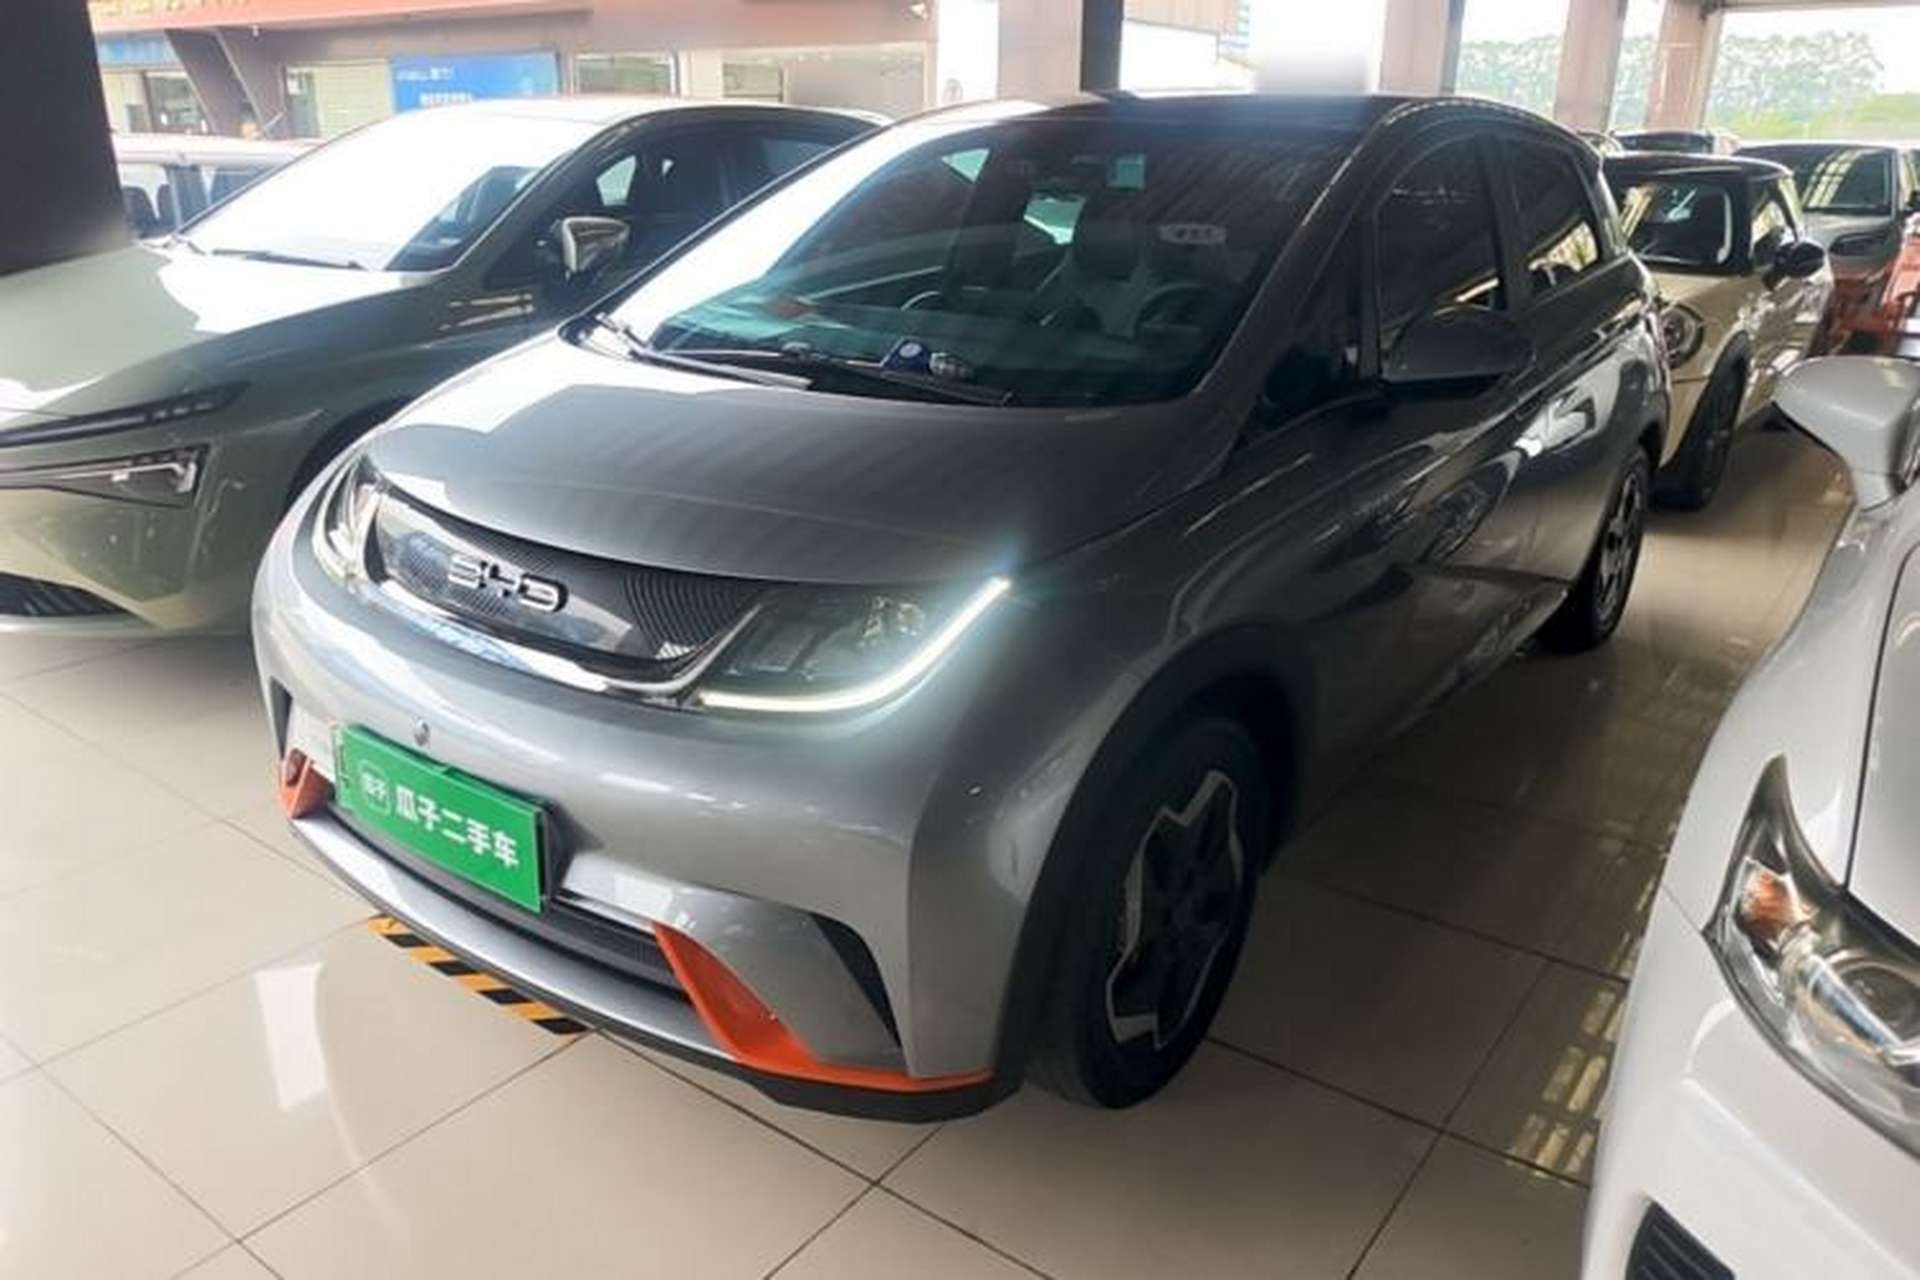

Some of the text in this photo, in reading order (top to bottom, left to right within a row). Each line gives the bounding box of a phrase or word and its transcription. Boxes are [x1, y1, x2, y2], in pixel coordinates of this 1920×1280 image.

[448, 552, 568, 612] BYD
[395, 784, 519, 868] 瓜子二手车
